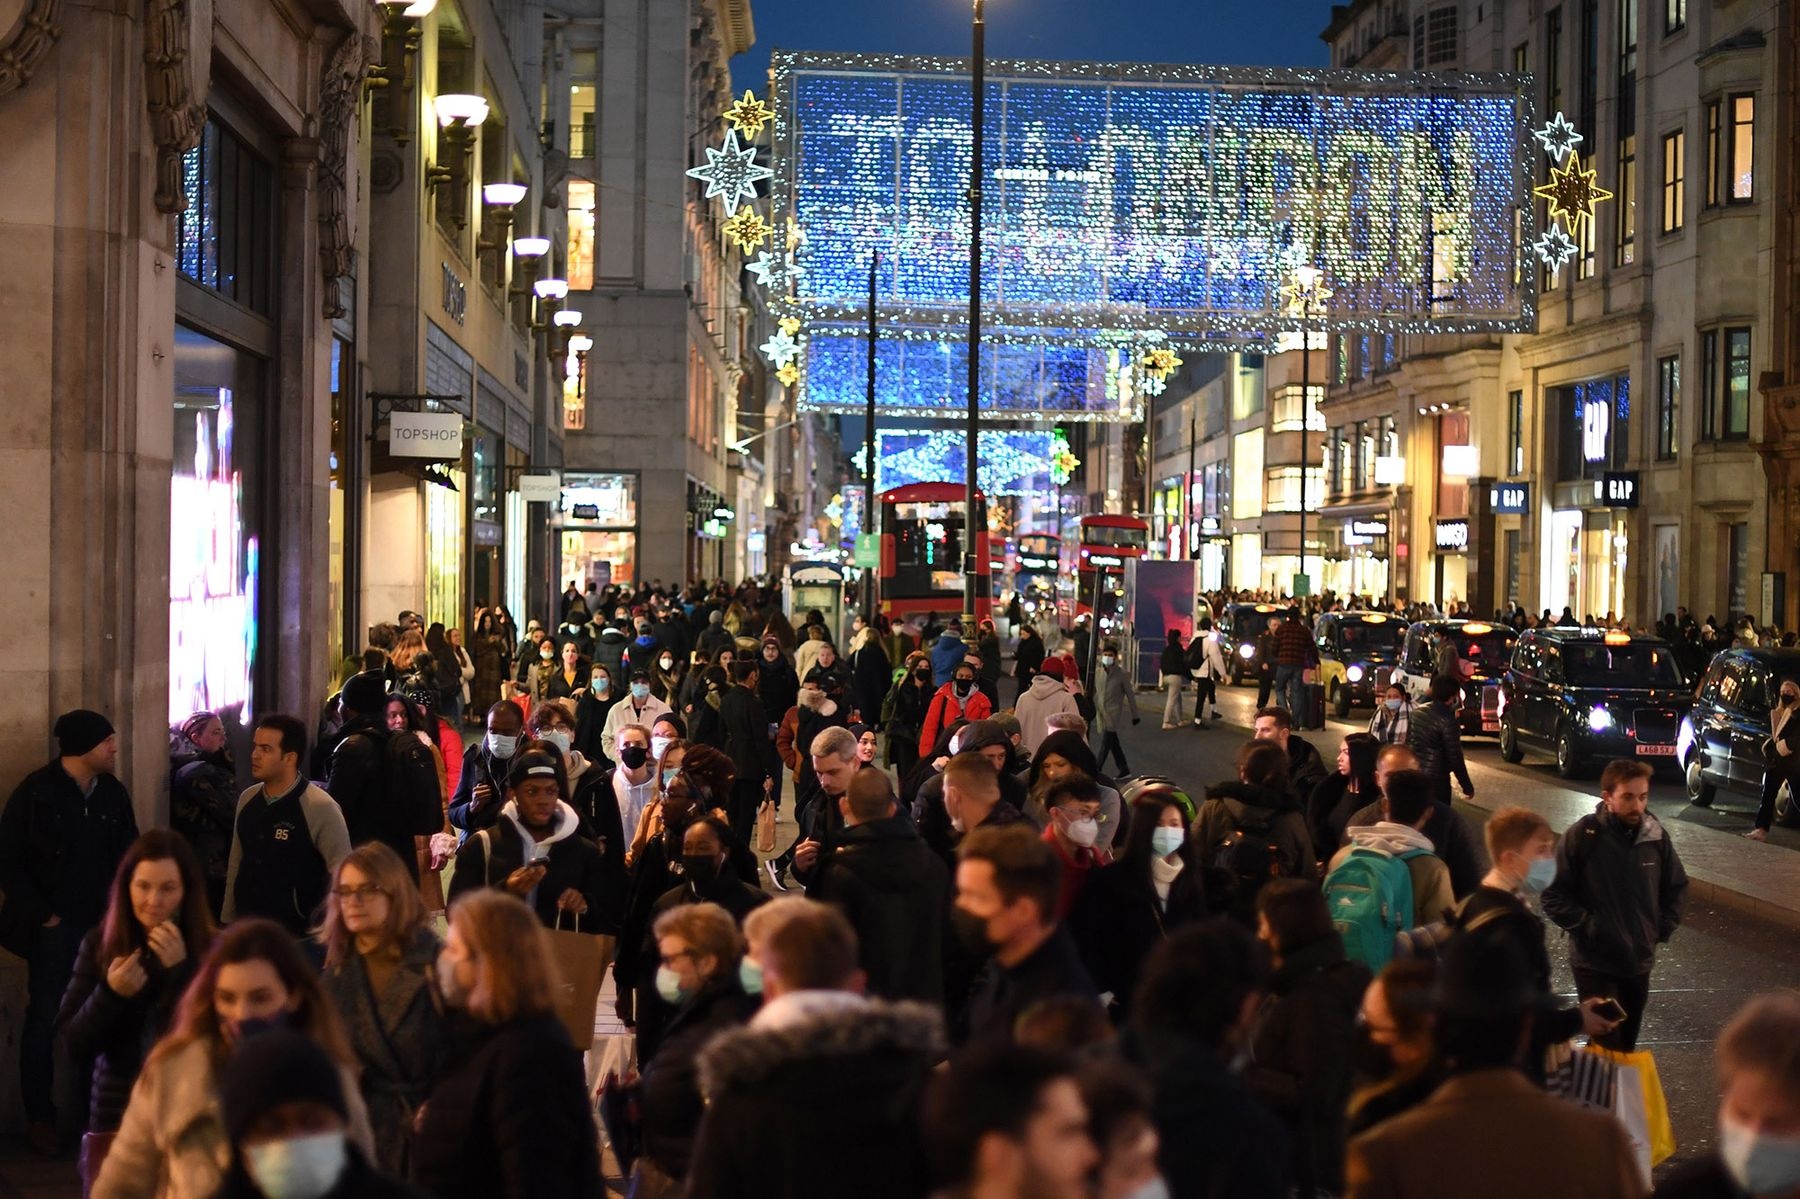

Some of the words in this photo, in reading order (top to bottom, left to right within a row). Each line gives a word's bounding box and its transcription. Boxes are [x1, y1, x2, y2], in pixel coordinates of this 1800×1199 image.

[1022, 120, 1473, 284] LONDON
[394, 427, 458, 440] TOPSHOP
[1609, 480, 1633, 499] GAP
[1503, 490, 1525, 507] GAP
[275, 829, 289, 840] 85
